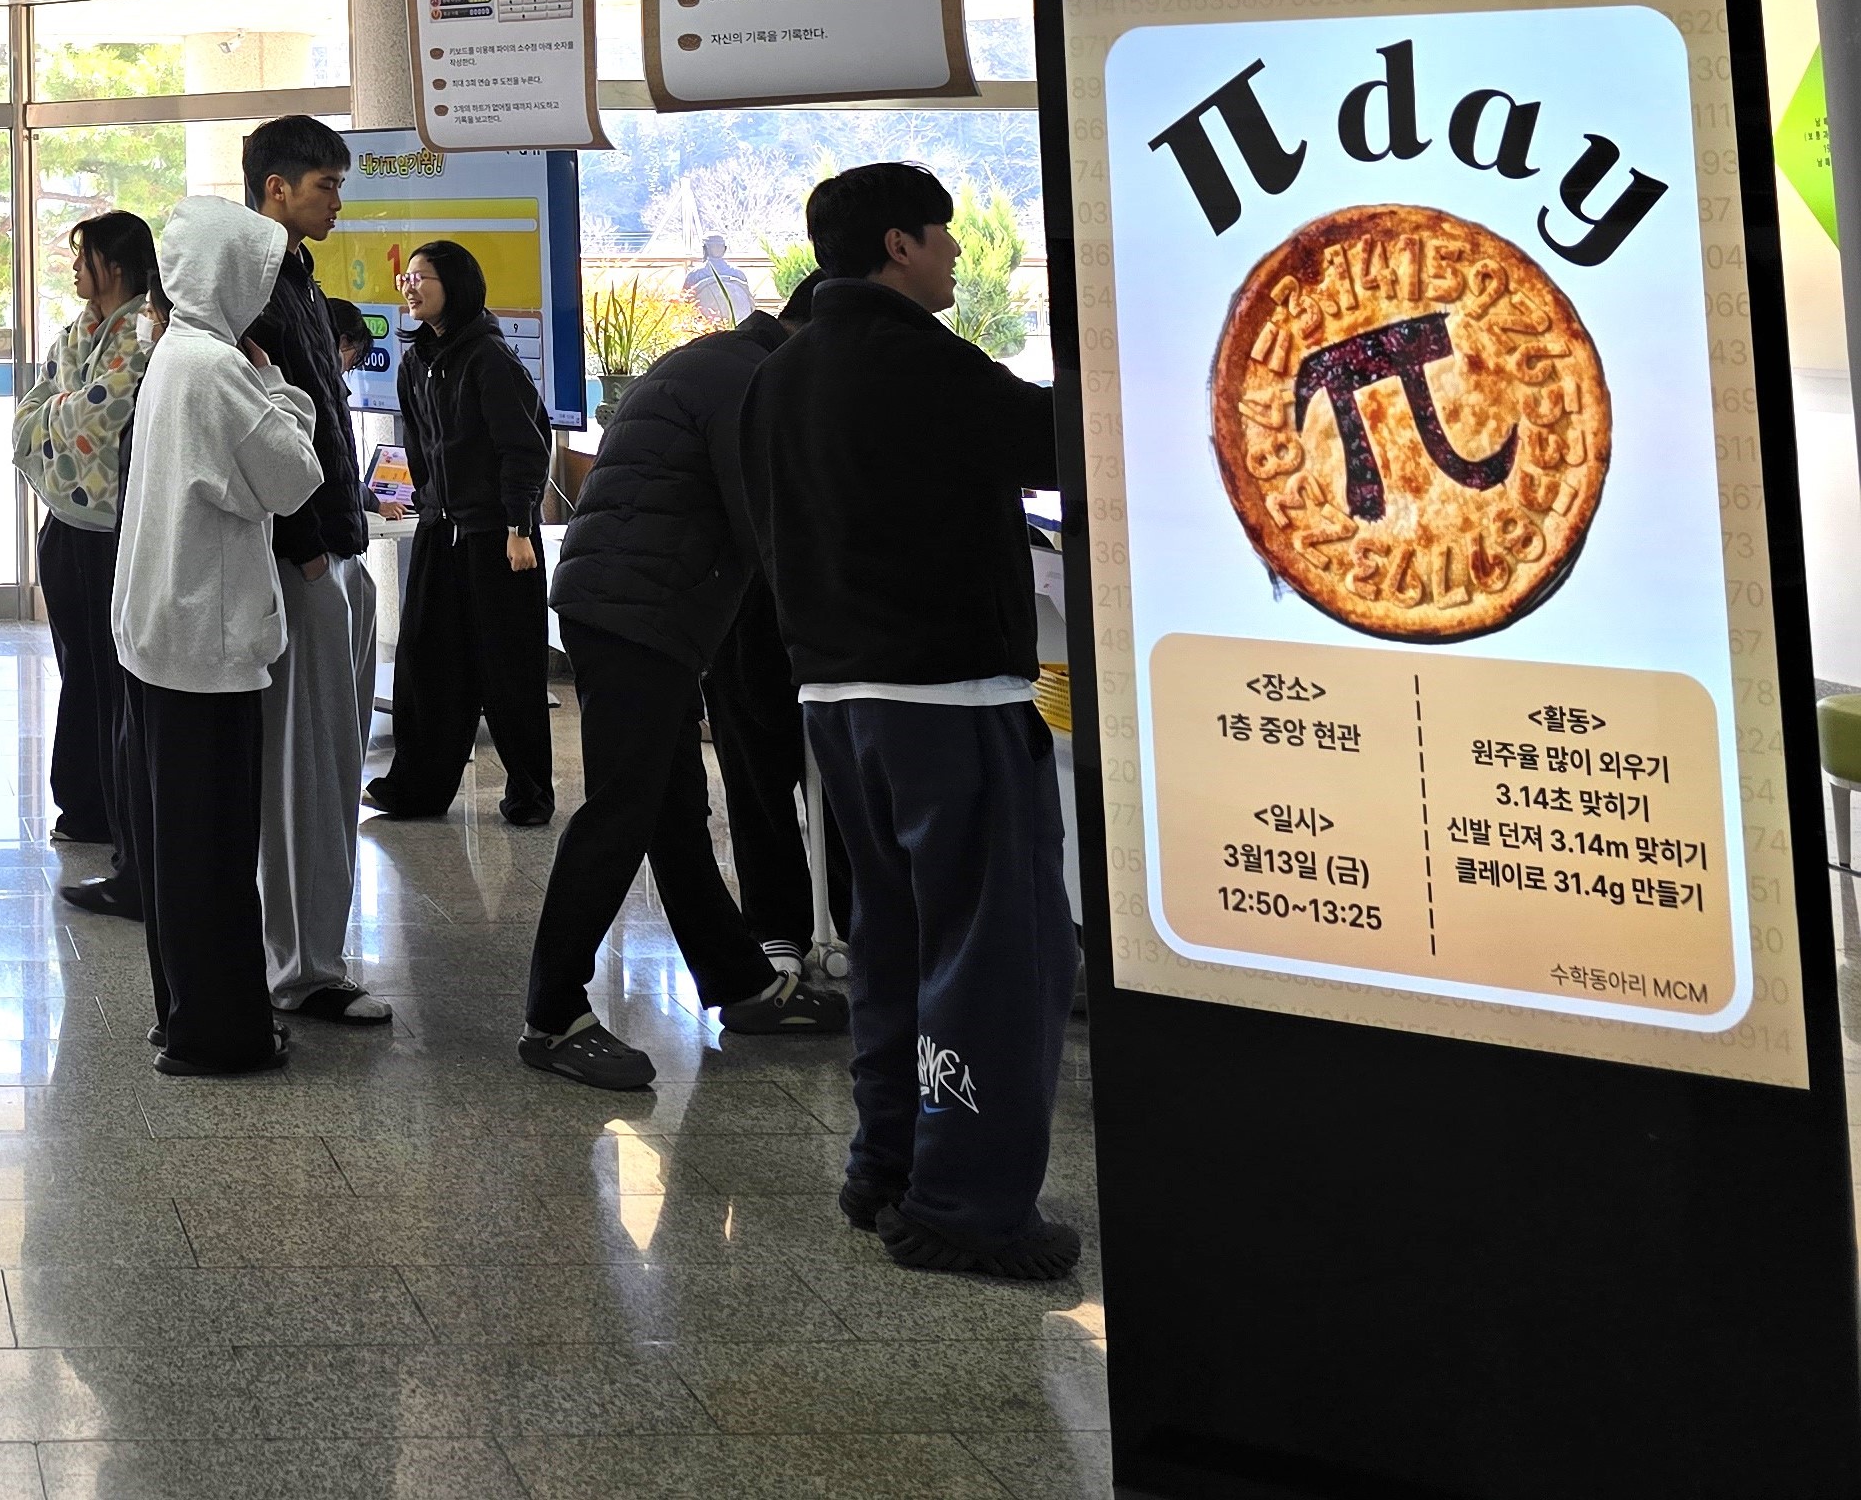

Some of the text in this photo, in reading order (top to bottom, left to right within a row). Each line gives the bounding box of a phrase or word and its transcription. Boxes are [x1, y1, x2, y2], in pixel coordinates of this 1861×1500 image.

[711, 28, 828, 45] 자신의 기록을 기록한다.
[1338, 39, 1669, 267] day
[352, 259, 365, 290] 3
[513, 323, 518, 333] 9
[1246, 674, 1326, 701] <장소>
[1217, 713, 1361, 752] 1층 중앙 현관
[1528, 705, 1606, 734] <활동>
[1472, 739, 1669, 783] 원주율 많이 외우기
[1253, 804, 1335, 837] <일시>
[1496, 783, 1649, 822] 3.14초 맞히기
[1447, 816, 1708, 870] 신발 던져 3.14m 맞히기
[1223, 844, 1369, 889] 3월13일 (금)
[1455, 856, 1704, 912] 클레이로 31.4g 만들기
[1218, 886, 1382, 930] 12:50~13:25
[1550, 963, 1708, 1004] 수학동아리 MCM
